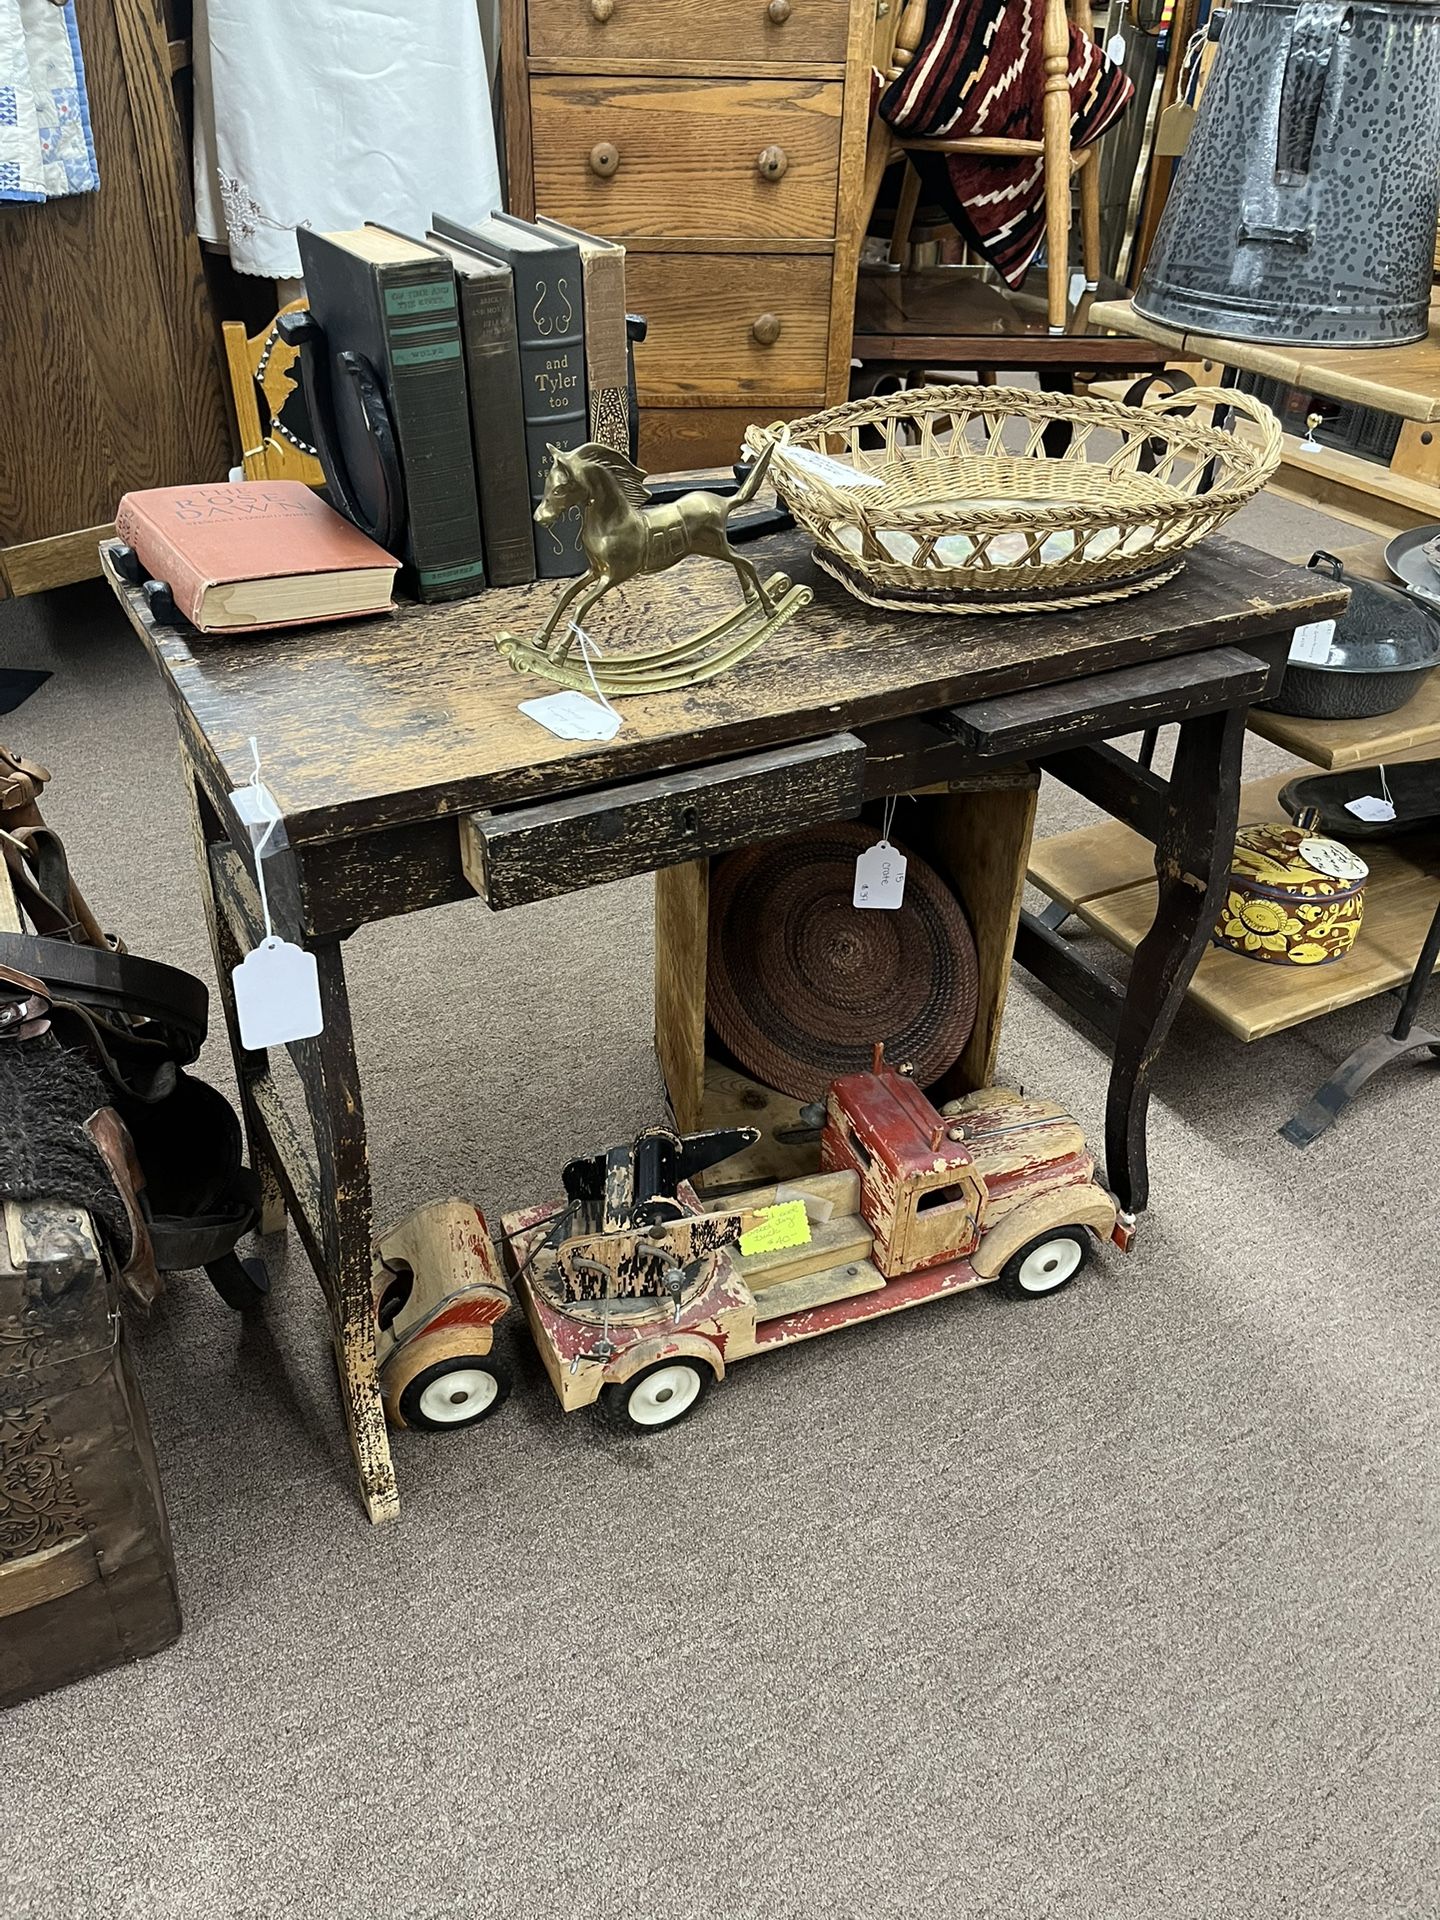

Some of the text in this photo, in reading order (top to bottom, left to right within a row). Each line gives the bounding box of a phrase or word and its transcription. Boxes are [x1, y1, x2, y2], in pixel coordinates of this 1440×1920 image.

[546, 354, 569, 370] and
[534, 373, 577, 394] Tyler
[549, 397, 569, 408] too
[192, 488, 250, 497] THE
[175, 493, 286, 509] ROSE
[175, 503, 307, 520] DAWN
